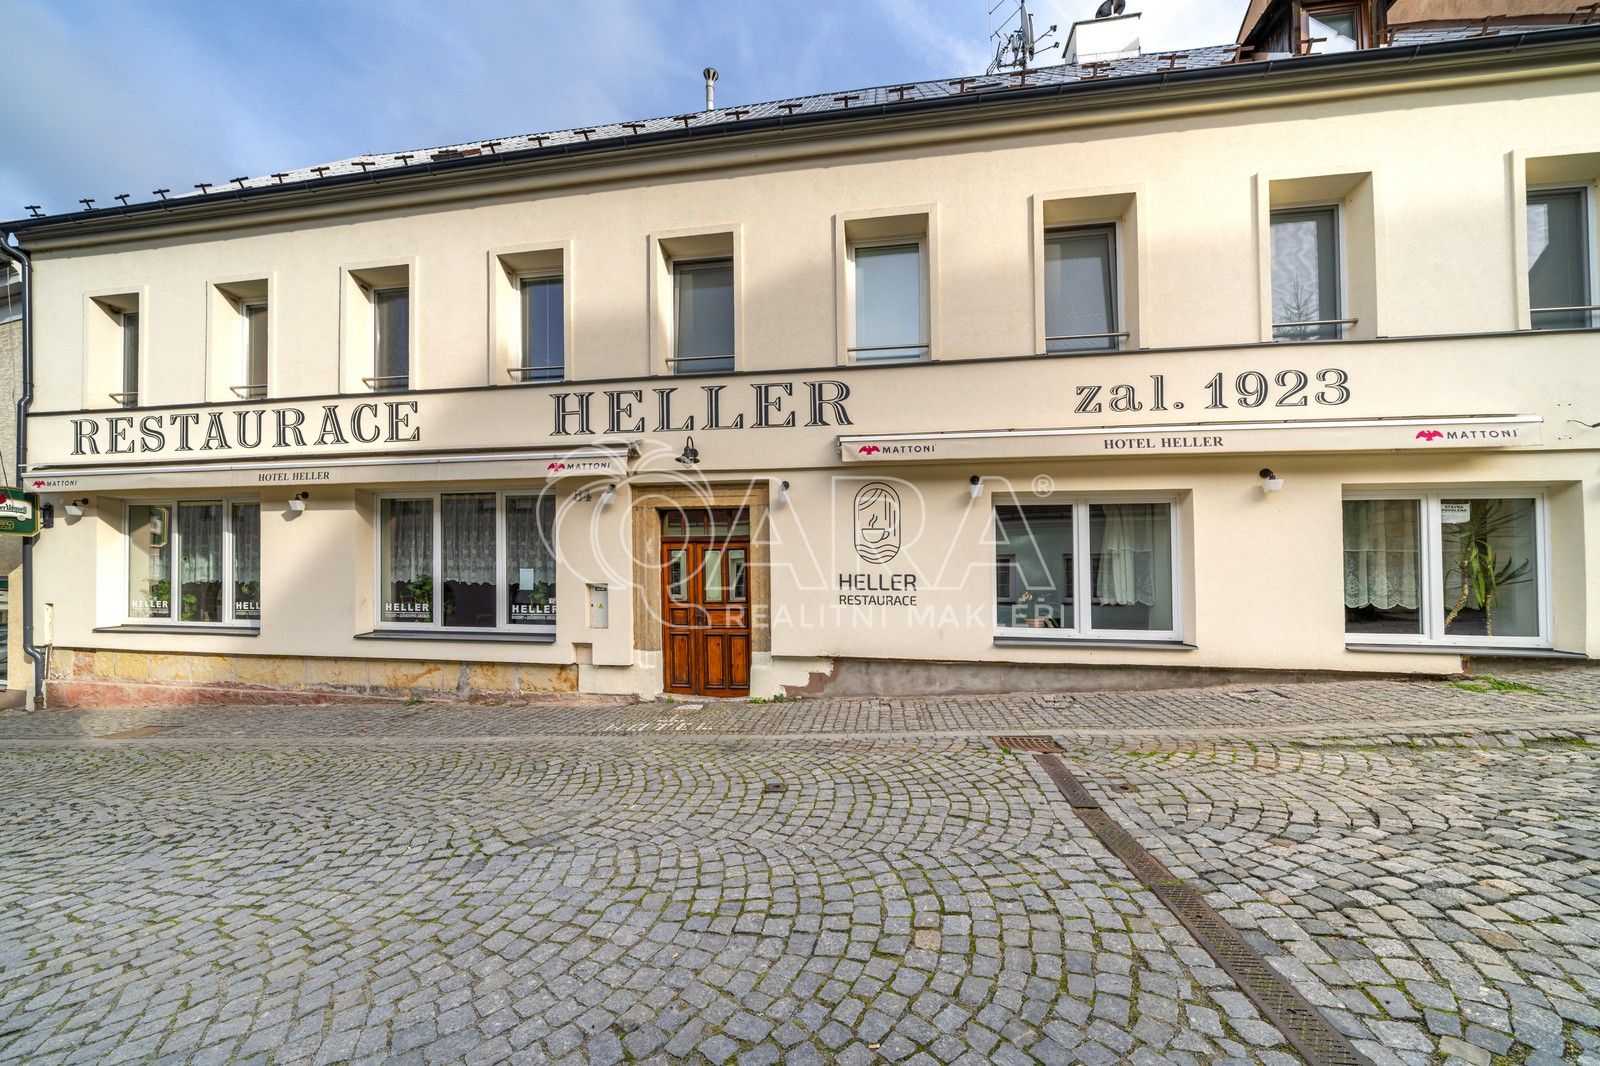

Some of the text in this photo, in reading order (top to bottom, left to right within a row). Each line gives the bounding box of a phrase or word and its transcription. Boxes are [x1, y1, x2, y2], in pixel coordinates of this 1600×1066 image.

[1074, 368, 1351, 413] zal. 1923
[549, 380, 855, 436] HELLER
[70, 401, 421, 456] RESTAURACE
[1446, 430, 1517, 440] MATTONI
[1104, 436, 1224, 450] HOTEL HELLER
[882, 445, 935, 455] MATTONI
[566, 461, 611, 471] MATTONI
[258, 471, 331, 483] HOTEL HELLER
[839, 573, 917, 592] HELLER
[132, 600, 169, 609] HELLER
[839, 594, 917, 607] RESTAURACE
[385, 602, 429, 612] HELLER
